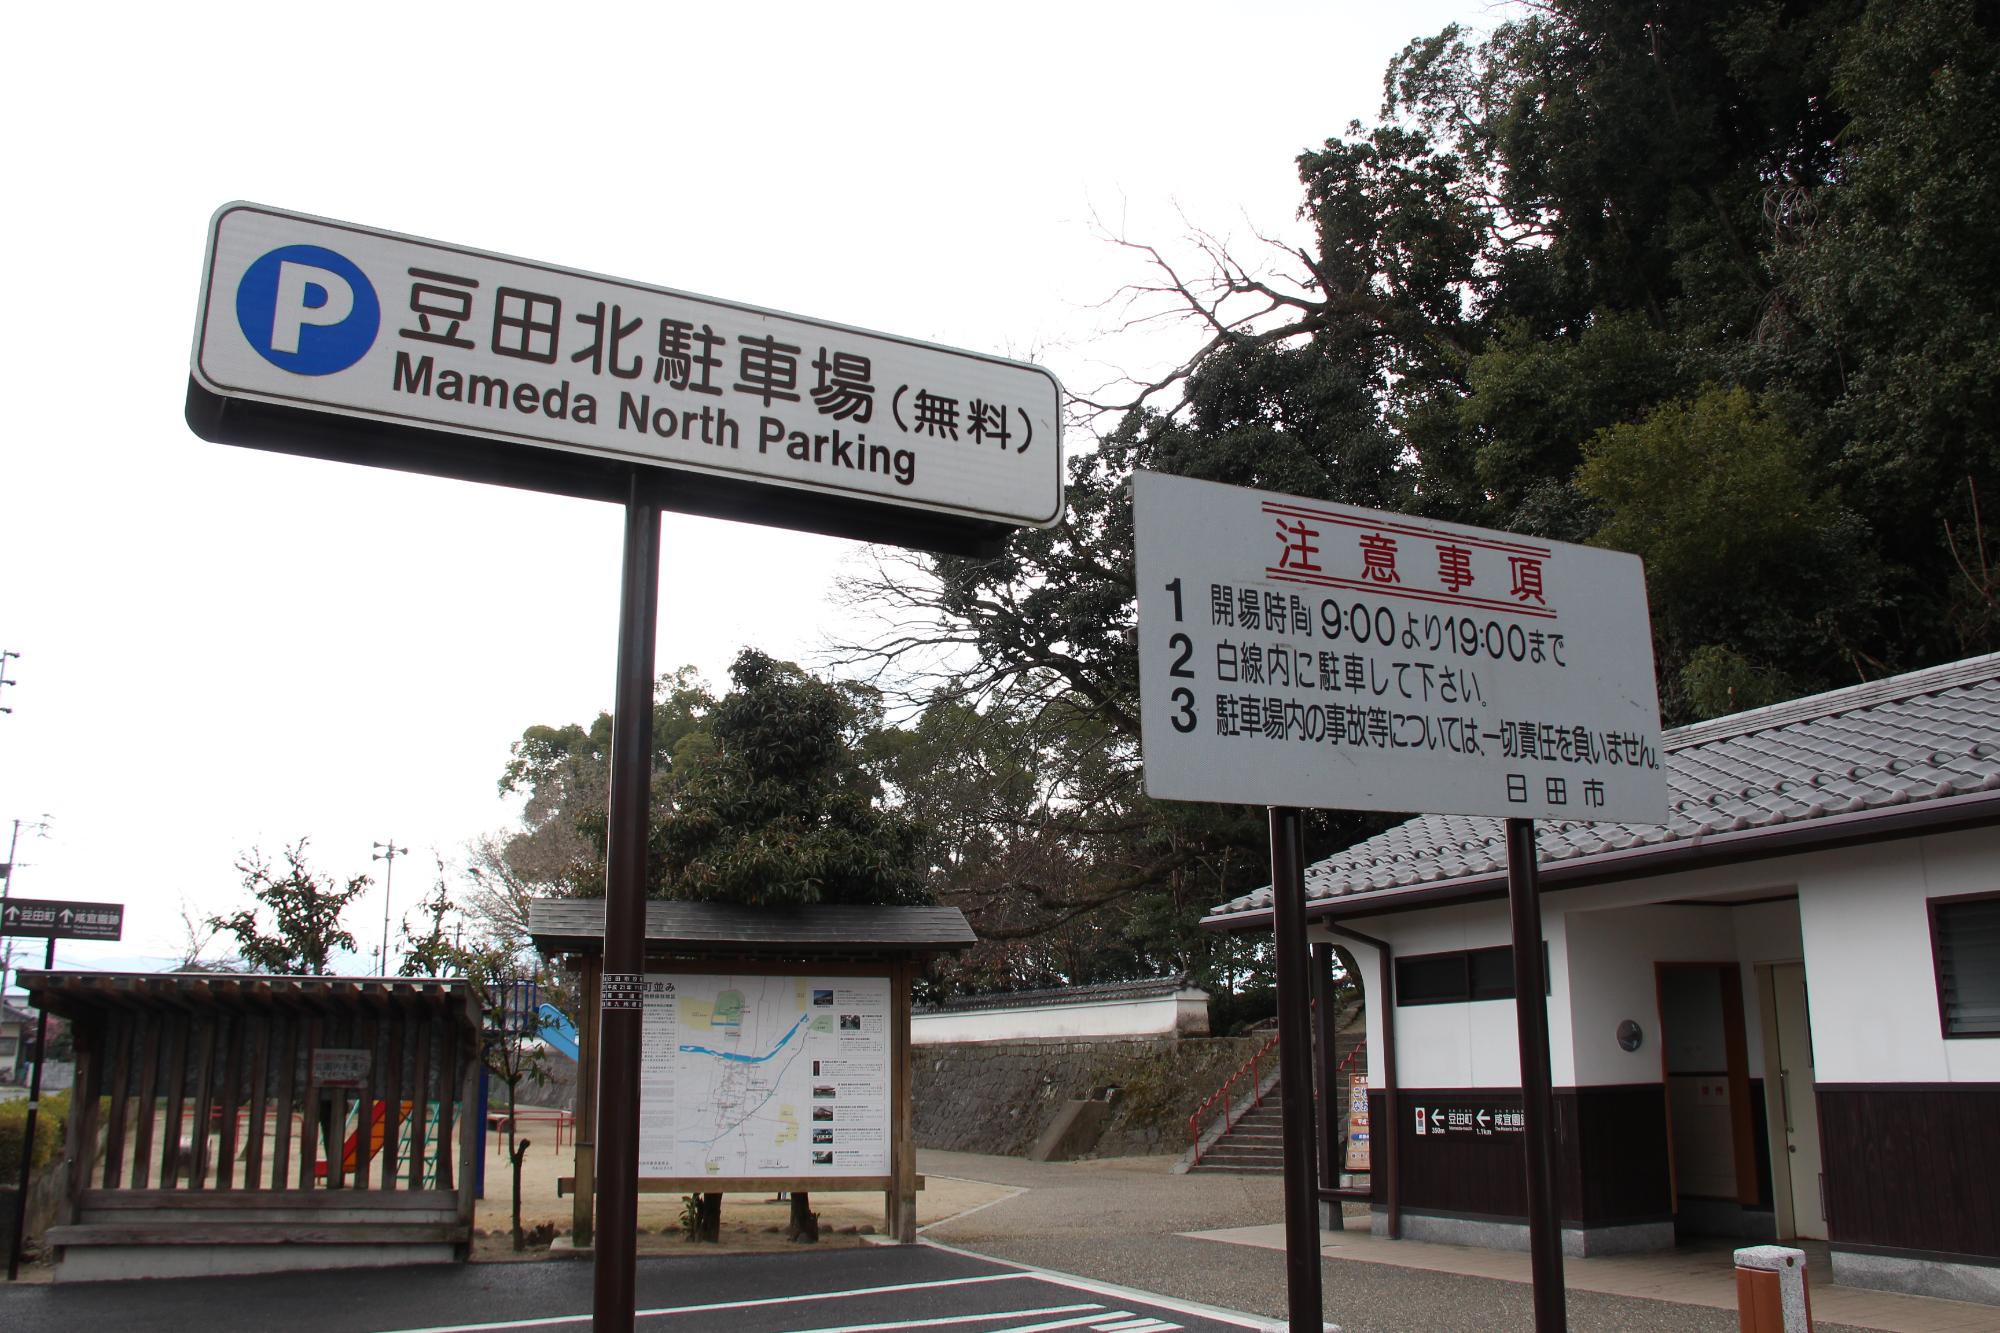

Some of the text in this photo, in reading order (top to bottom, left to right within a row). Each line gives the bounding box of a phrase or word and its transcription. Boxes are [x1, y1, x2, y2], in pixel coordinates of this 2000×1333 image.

[270, 260, 355, 354] P
[393, 351, 916, 487] Mameda North Parking
[1165, 577, 1184, 623] 1
[1275, 517, 1547, 607] 注意事項
[1169, 633, 1488, 708] 2 白線内に駐車して下さい。
[1171, 687, 1661, 771] 3 駐車場内の事故等については、一切責任を負いません。
[1506, 774, 1605, 809] 日田市
[1448, 1113, 1473, 1125] 豆田町
